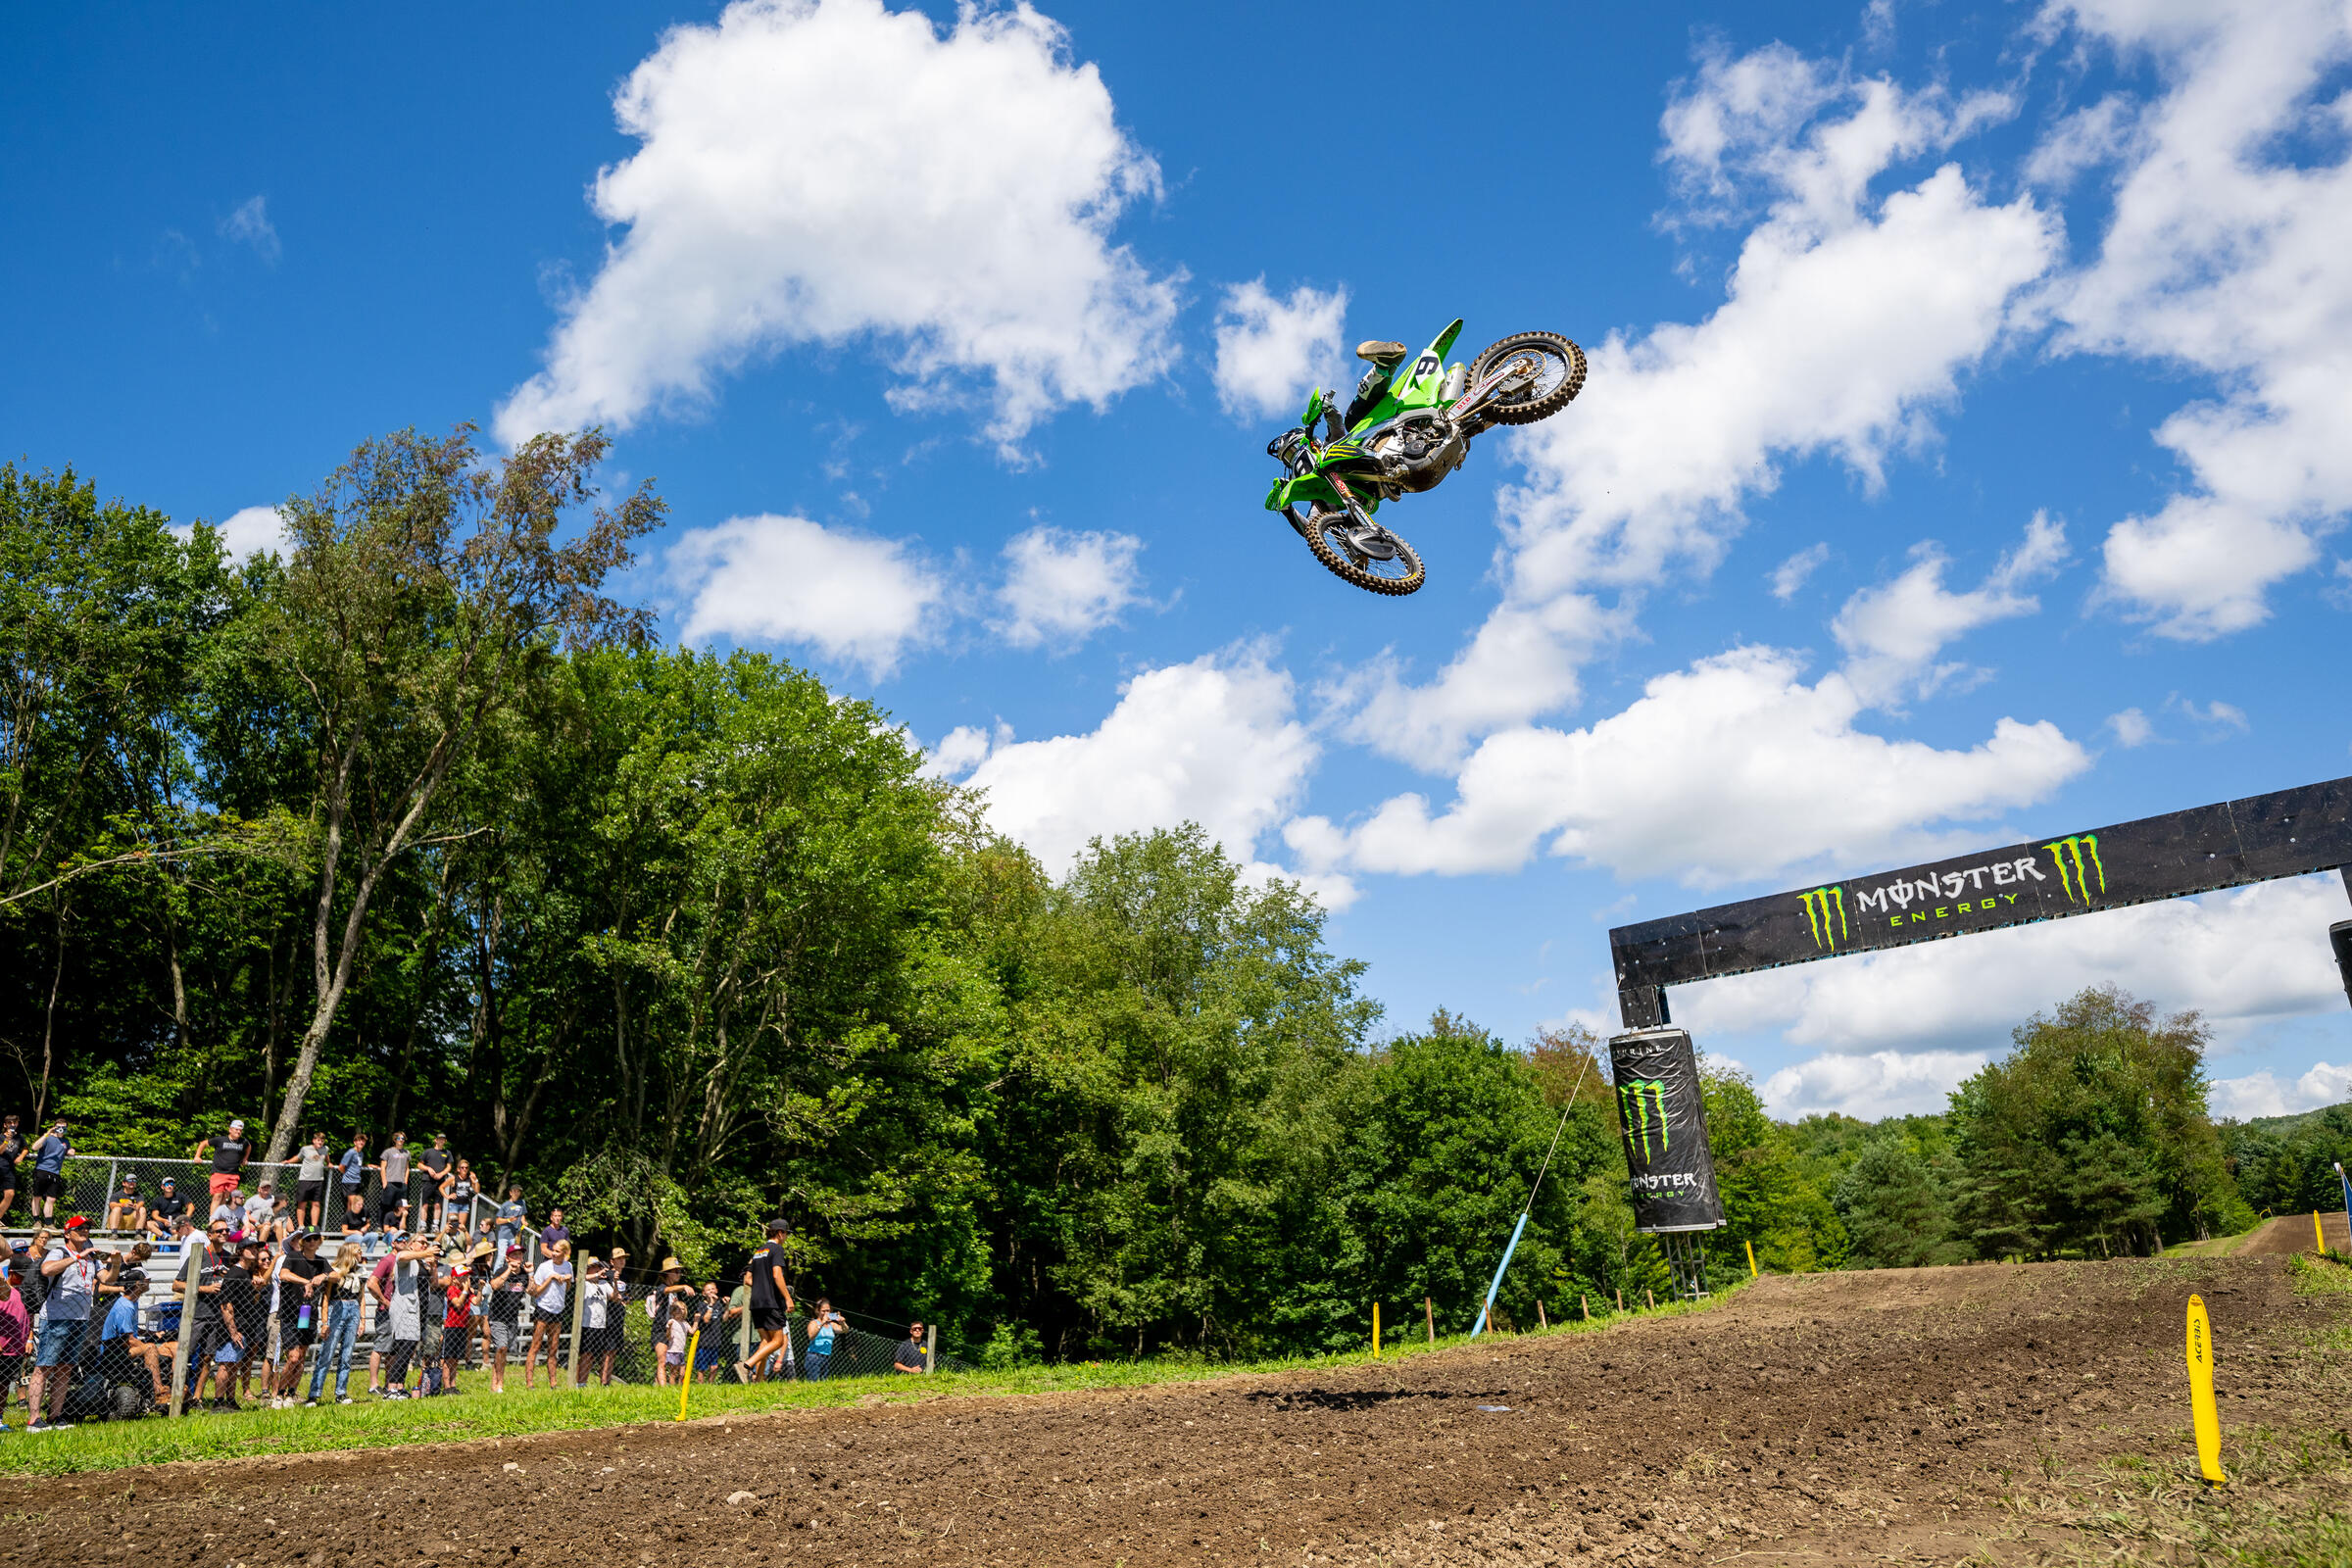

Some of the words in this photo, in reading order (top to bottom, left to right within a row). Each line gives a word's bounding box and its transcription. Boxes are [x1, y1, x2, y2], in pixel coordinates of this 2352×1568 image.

[1415, 356, 1440, 376] 9
[1855, 856, 2046, 913] MONSTER
[1889, 892, 2019, 927] ENERGY
